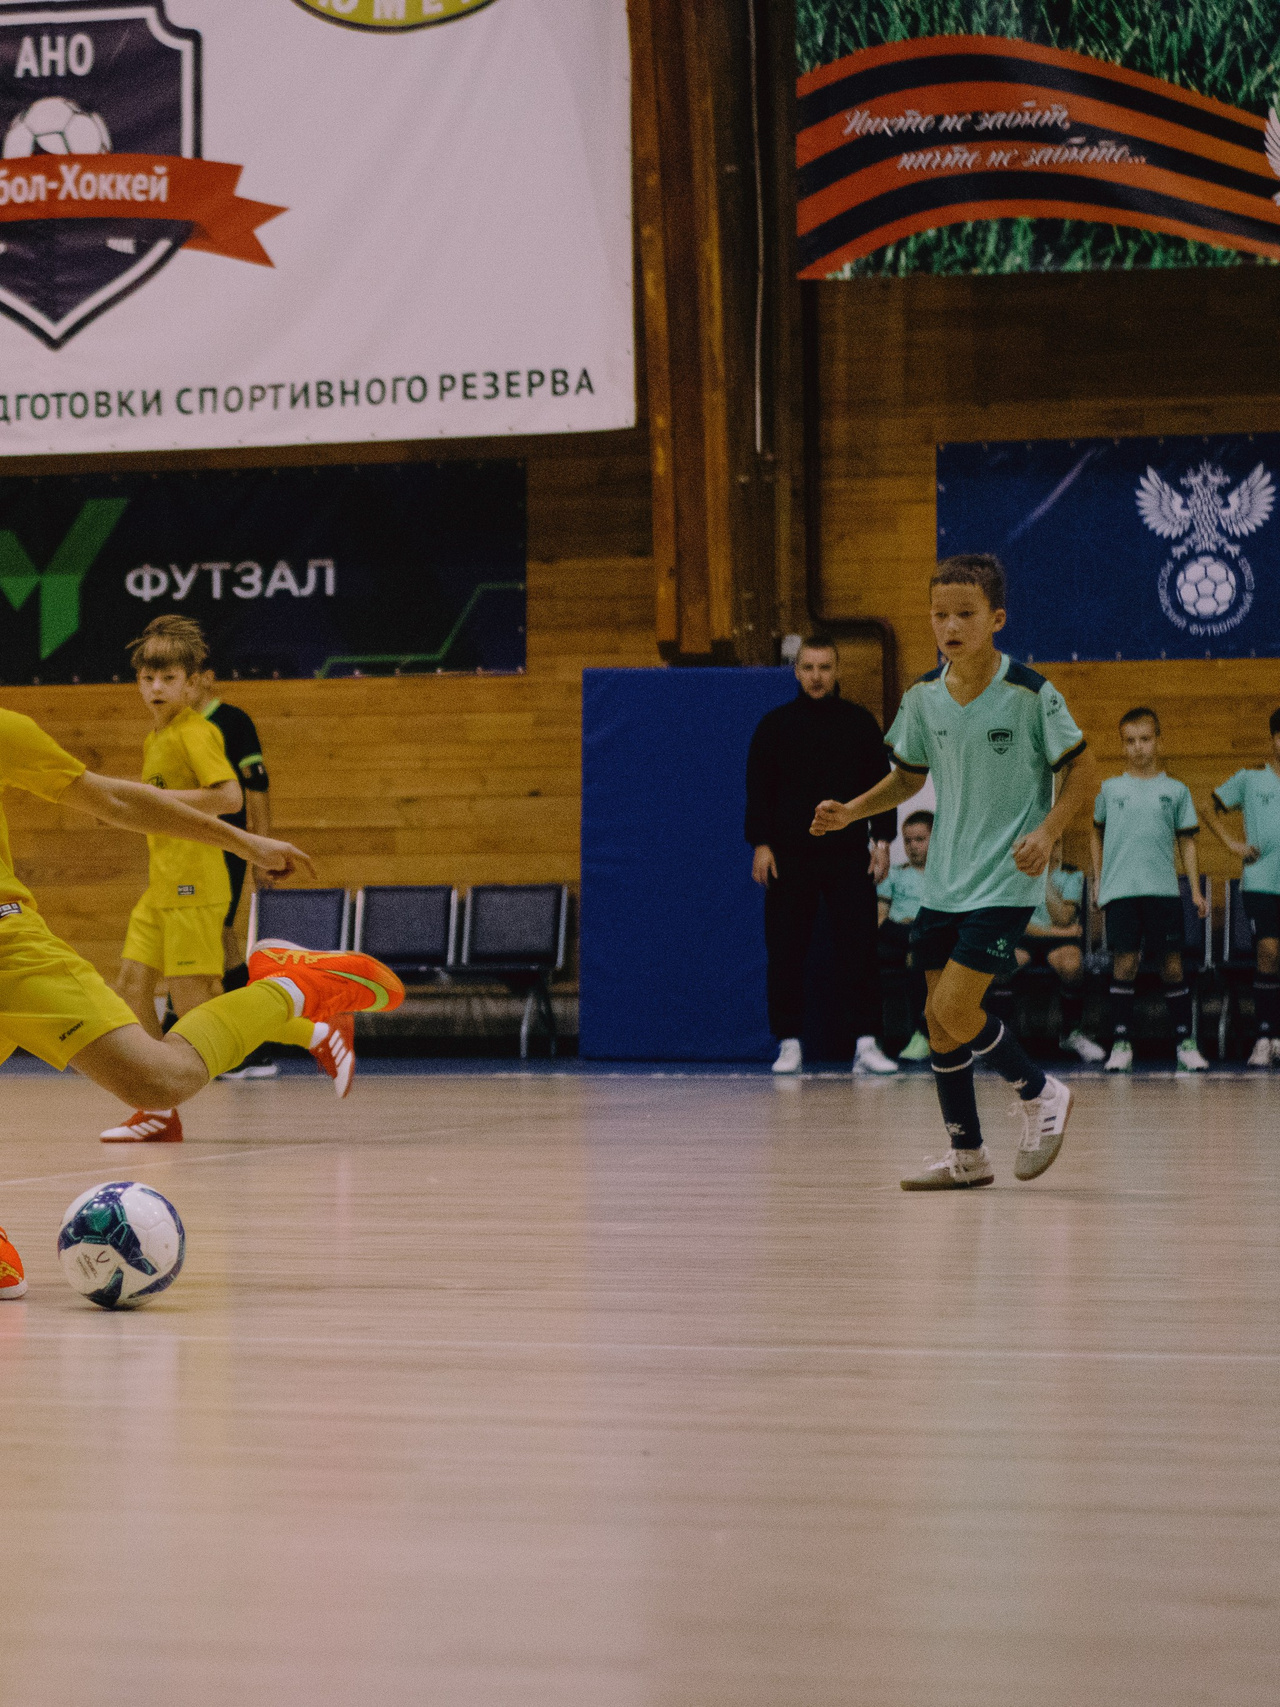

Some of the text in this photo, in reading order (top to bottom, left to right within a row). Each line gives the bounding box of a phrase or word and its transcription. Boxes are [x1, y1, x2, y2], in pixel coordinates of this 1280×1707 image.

[14, 33, 95, 79] АНО
[175, 374, 429, 415] СПОРТИВНОГО
[438, 366, 595, 402] РЕЗЕРВА
[126, 558, 336, 602] ФУТЗАЛ
